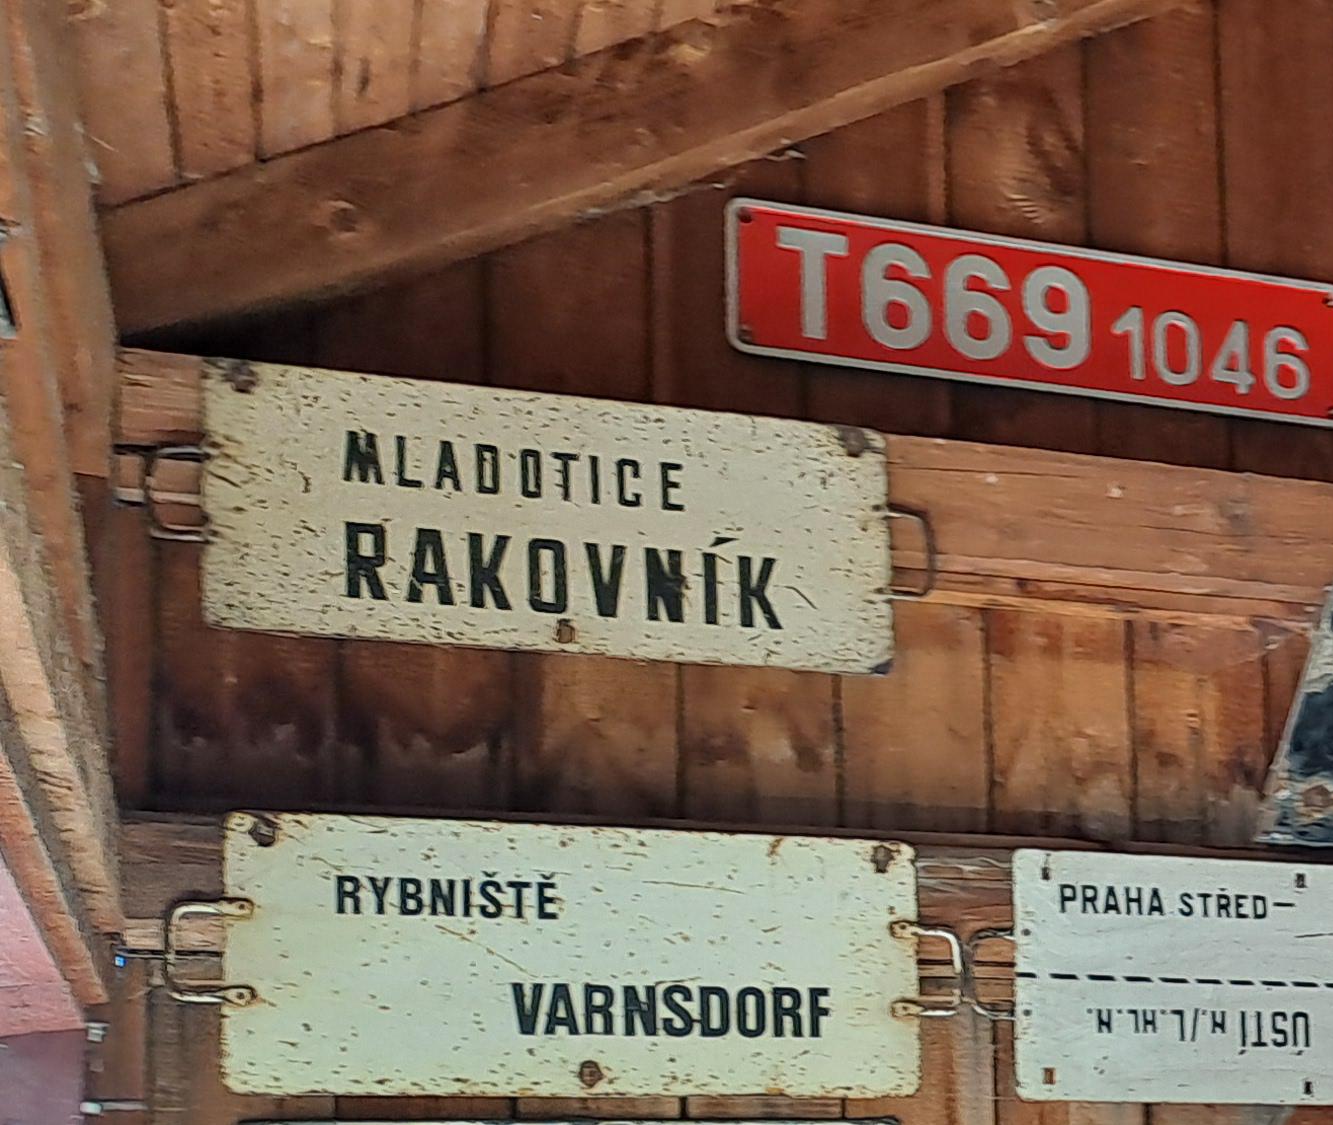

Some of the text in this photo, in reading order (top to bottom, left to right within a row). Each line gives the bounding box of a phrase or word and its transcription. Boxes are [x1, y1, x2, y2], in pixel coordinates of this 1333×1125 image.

[775, 226, 1311, 400] T669 1046
[341, 429, 685, 512] MLADOTICE
[343, 520, 784, 630] RAKOVNÍK
[334, 872, 561, 921] RYBNIŠTĚ
[1058, 884, 1166, 917] PRAHA
[508, 981, 833, 1039] VARNSDORF
[1238, 1009, 1312, 1057] ÚSTÍ
